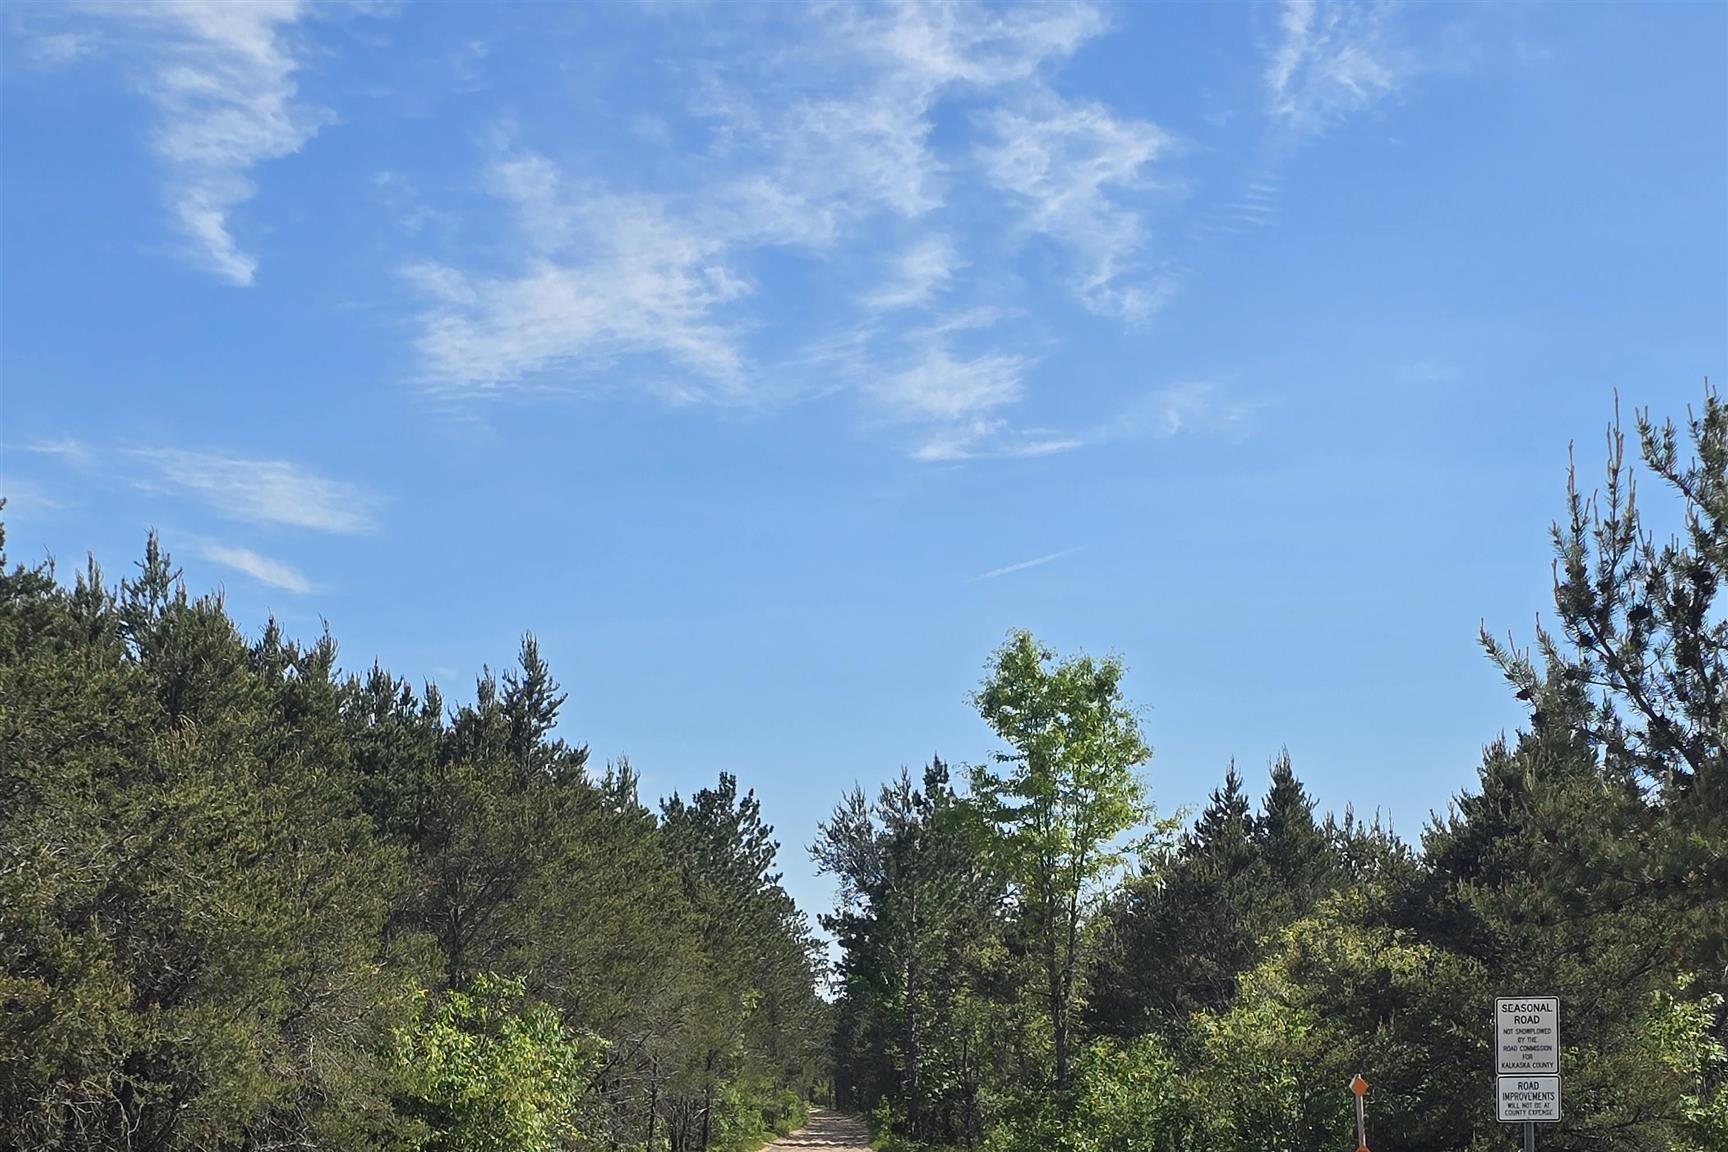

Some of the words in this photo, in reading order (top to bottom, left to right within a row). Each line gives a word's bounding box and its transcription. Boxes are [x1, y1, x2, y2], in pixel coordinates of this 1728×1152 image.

[1502, 1003, 1552, 1013] SEASONAL
[1514, 1015, 1540, 1024] ROAD
[1517, 1081, 1540, 1091] ROAD
[1502, 1092, 1555, 1101] IMPROVEMENTS
